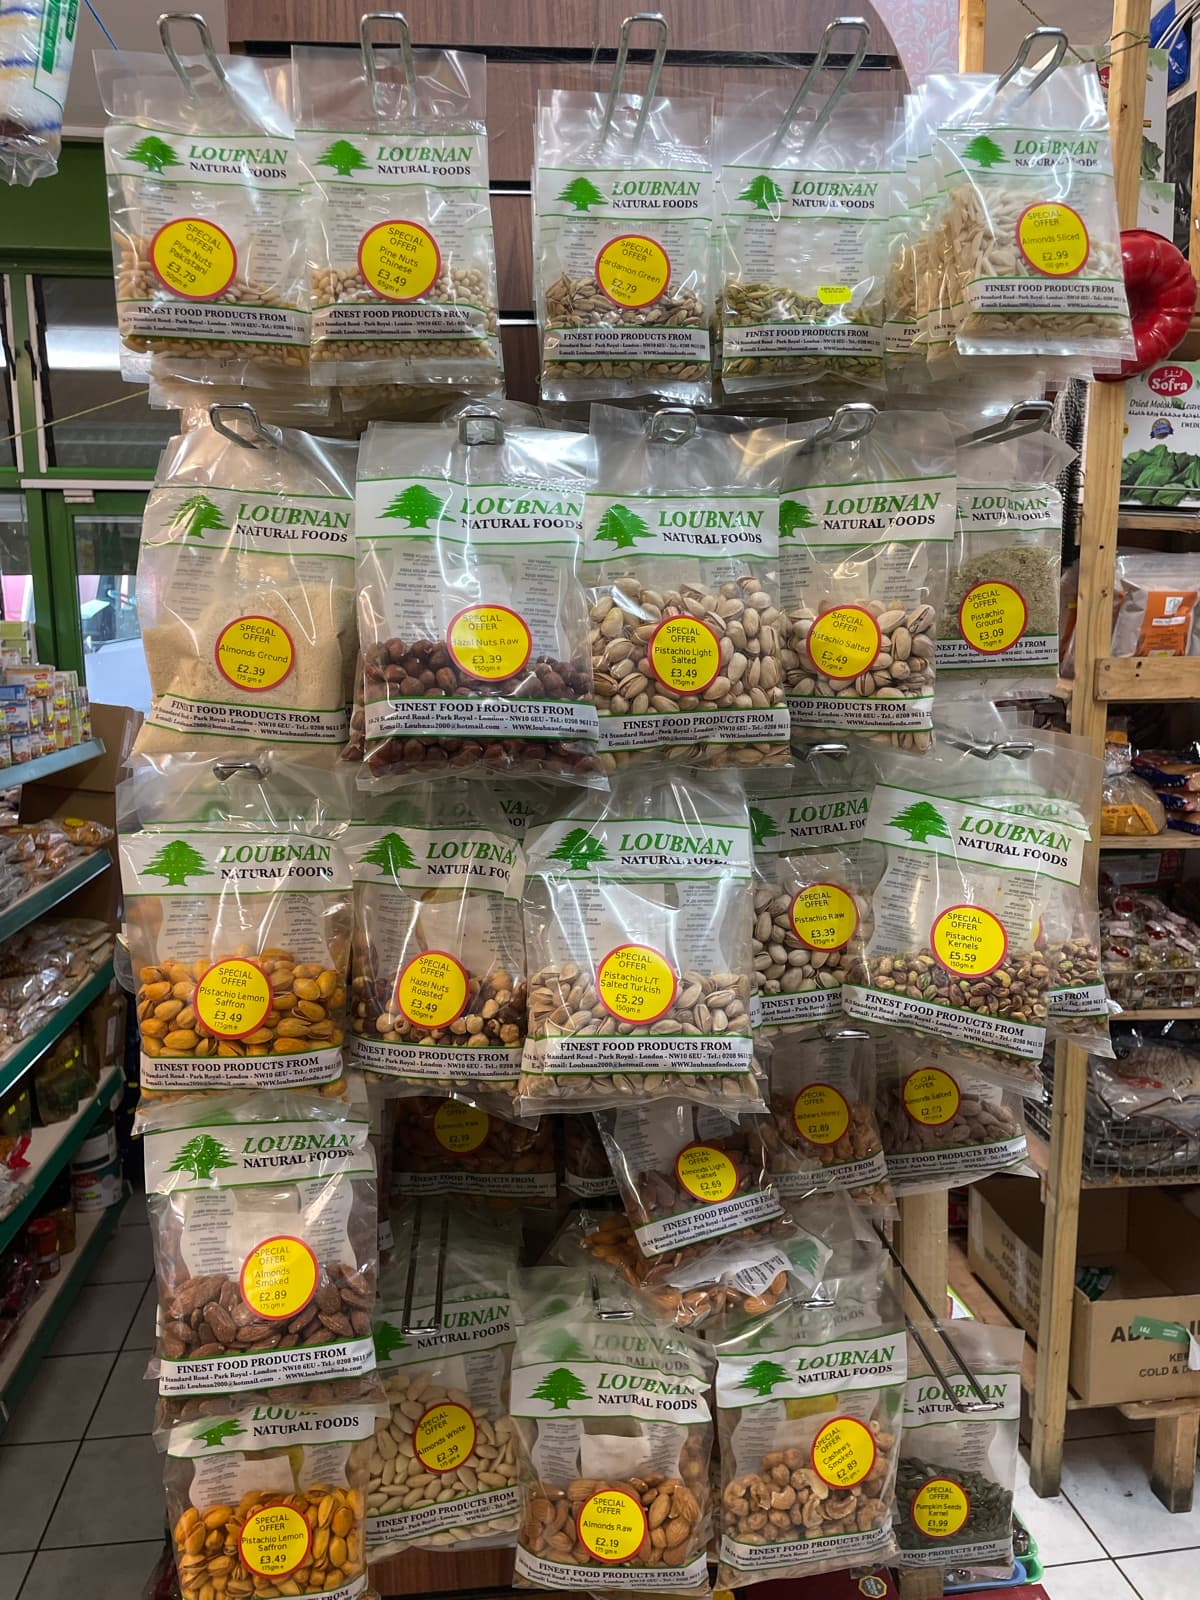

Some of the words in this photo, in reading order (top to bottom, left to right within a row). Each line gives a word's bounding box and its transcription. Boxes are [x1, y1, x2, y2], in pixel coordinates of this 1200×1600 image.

[1013, 140, 1099, 154] LOUBNAN
[377, 146, 473, 162] LOUBNAN
[378, 165, 430, 174] NATURAL
[433, 166, 471, 175] FOODS
[612, 181, 700, 196] LOUBNAN
[792, 181, 877, 196] LOUBNAN
[613, 200, 660, 208] NATURAL
[663, 200, 698, 208] FOODS
[1022, 235, 1055, 245] Almonds
[1056, 234, 1080, 243] Sliced
[173, 240, 192, 255] Pine
[192, 253, 213, 268] Nuts
[380, 247, 398, 260] Pine
[398, 254, 418, 267] Nuts
[1042, 251, 1069, 261] £2.99
[169, 248, 208, 275] Pakistani
[379, 256, 412, 274] Chinese
[167, 262, 196, 283] £3.79
[377, 269, 407, 286] £3.49
[638, 270, 661, 284] Green
[611, 279, 637, 293] £2.79
[1044, 285, 1090, 293] PRODUCTS
[1152, 378, 1187, 391] Sofra
[1130, 399, 1148, 407] Dried
[460, 497, 583, 517] LOUBNAN
[823, 492, 940, 515] LOUBNAN
[238, 504, 351, 528] LOUBNAN
[659, 511, 763, 529] LOUBNAN
[823, 520, 885, 529] NATURAL
[889, 515, 935, 527] FOODS
[462, 519, 529, 530] NATURAL
[534, 519, 583, 530] FOODS
[236, 524, 298, 540] NATURAL
[301, 529, 348, 543] FOODS
[663, 533, 719, 545] NATURAL
[722, 533, 762, 543] FOODS
[971, 609, 1004, 622] Pistachio
[975, 618, 1003, 629] Ground
[239, 624, 276, 637] SPECIAL
[666, 627, 700, 636] SPECIAL
[980, 628, 1004, 641] £3.09
[243, 633, 270, 644] OFFER
[476, 639, 497, 647] Nuts
[500, 638, 519, 646] Raw
[671, 635, 696, 643] OFFER
[810, 631, 843, 646] Pistachio
[845, 640, 870, 652] Salted
[219, 644, 256, 658] Almonds
[258, 651, 288, 663] Ground
[655, 647, 690, 656] Pistachio
[693, 648, 712, 658] Light
[472, 655, 502, 664] £3.39
[671, 656, 696, 664] Salted
[237, 664, 265, 676] £2.39
[670, 669, 697, 678] £3.49
[453, 714, 472, 722] Royal
[790, 824, 847, 838] NATURAL
[959, 816, 1072, 852] LOUBNAN
[619, 833, 733, 856] LOUBNAN
[222, 845, 331, 863] LOUBNAN
[958, 836, 1020, 857] NATURAL
[1023, 847, 1068, 867] FOODS
[221, 868, 285, 879] NATURAL
[288, 867, 334, 877] FOODS
[427, 865, 487, 876] NATURAL
[794, 914, 827, 924] Pistachio
[829, 912, 845, 920] Raw
[811, 928, 835, 938] £3.39
[945, 931, 982, 942] Pistachio
[948, 940, 979, 950] Kernels
[615, 952, 652, 963] SPECIAL
[950, 952, 976, 962] £5.59
[618, 961, 647, 970] OFFER
[410, 976, 429, 989] Hazel
[430, 982, 449, 993] Nuts
[604, 972, 642, 983] Pistachio
[644, 976, 659, 984] L/T
[411, 986, 443, 1000] Roasted
[600, 979, 628, 989] Salted
[630, 983, 661, 995] Turkish
[200, 987, 236, 999] Pistachio
[237, 993, 265, 1002] Lemon
[615, 993, 644, 1006] £5.29
[215, 998, 245, 1009] Saffron
[411, 999, 438, 1013] £3.49
[214, 1010, 242, 1022] £3.49
[560, 1042, 600, 1051] FINEST
[603, 1042, 634, 1051] FOOD
[637, 1042, 697, 1051] PRODUCTS
[700, 1042, 731, 1051] FROM
[242, 1135, 354, 1154] LOUBNAN
[243, 1154, 306, 1168] NATURAL
[310, 1150, 355, 1162] FOODS
[681, 1167, 708, 1177] Almonds
[709, 1163, 725, 1174] Light
[696, 1172, 717, 1180] Salted
[700, 1180, 721, 1190] £2.69
[255, 1268, 289, 1278] Almonds
[256, 1278, 289, 1288] Smoked
[259, 1290, 287, 1302] £2.89
[177, 1360, 214, 1374] FINEST
[217, 1358, 248, 1370] FOOD
[251, 1353, 311, 1368] PRODUCTS
[314, 1348, 347, 1361] FROM
[796, 1346, 895, 1371] LOUBNAN
[798, 1369, 851, 1383] NATURAL
[853, 1364, 893, 1376] FOODS
[1139, 1367, 1168, 1377] COLD
[1171, 1366, 1179, 1374] &
[597, 1373, 695, 1396] LOUBNAN
[598, 1394, 653, 1409] NATURAL
[656, 1399, 697, 1410] FOODS
[253, 1422, 312, 1436] NATURAL
[316, 1417, 359, 1430] FOODS
[416, 1434, 446, 1456] Almonds
[447, 1424, 466, 1440] White
[436, 1445, 458, 1463] £2.39
[823, 1442, 851, 1464] Cashews
[827, 1450, 854, 1471] Smoked
[836, 1460, 858, 1478] £2.89
[917, 1504, 942, 1512] Pumpkin
[583, 1521, 615, 1530] Almonds
[617, 1524, 632, 1532] Raw
[241, 1536, 277, 1544] Pistachio
[278, 1532, 304, 1541] Lemon
[596, 1538, 618, 1547] £2.19
[260, 1555, 286, 1564] £3.49
